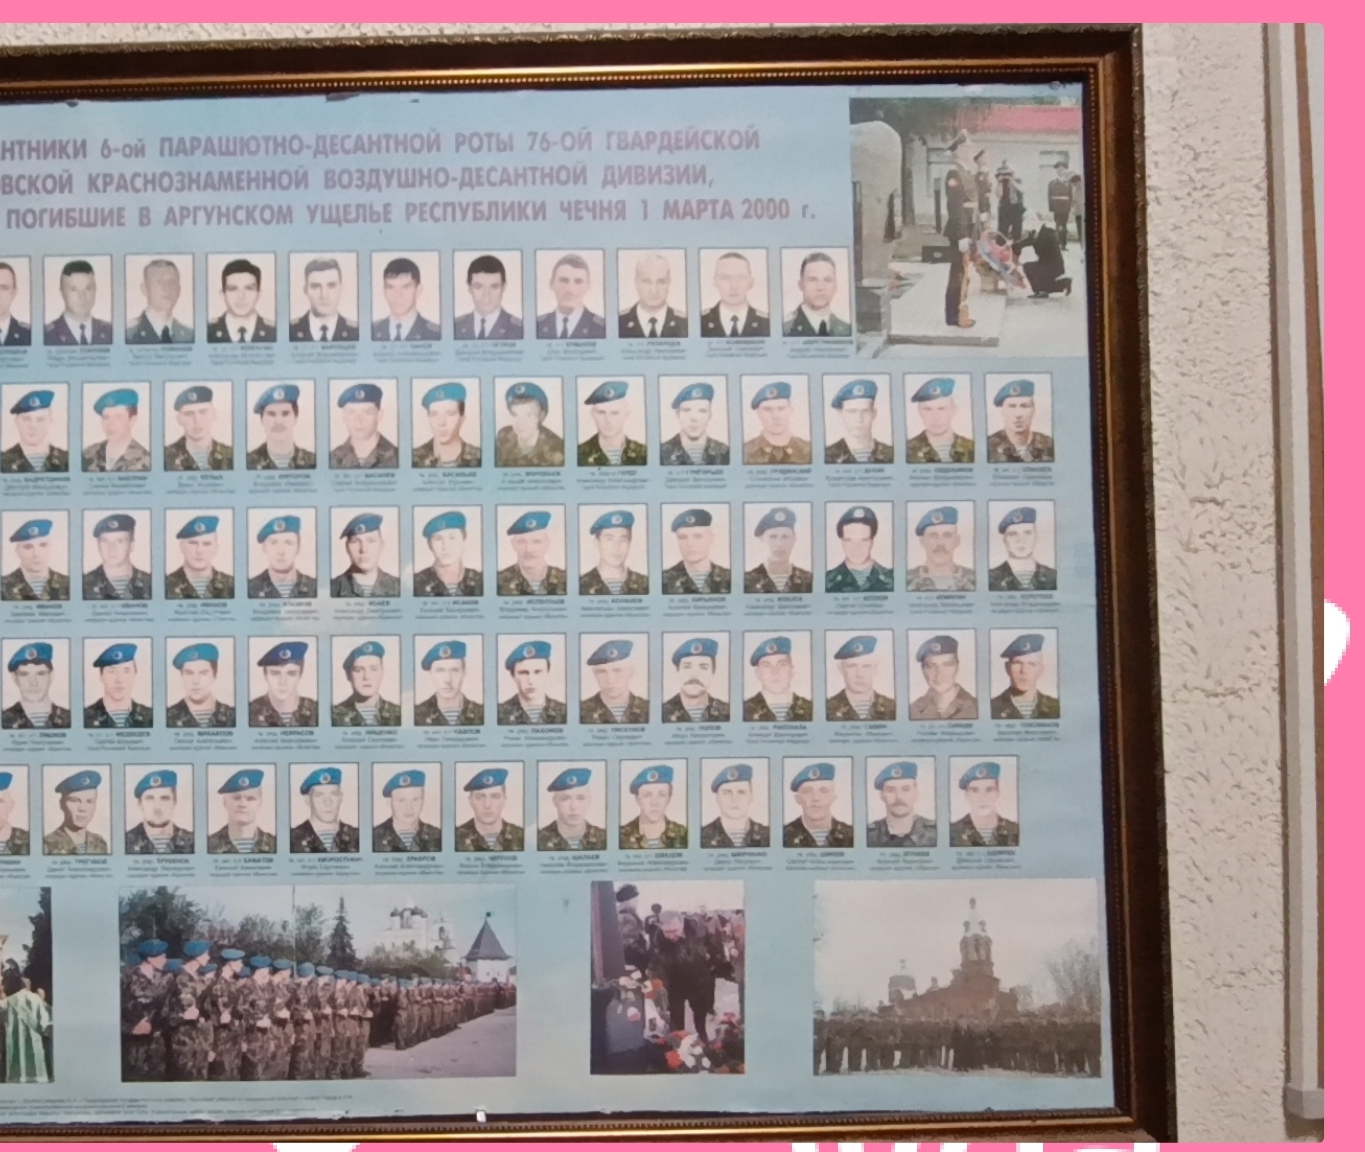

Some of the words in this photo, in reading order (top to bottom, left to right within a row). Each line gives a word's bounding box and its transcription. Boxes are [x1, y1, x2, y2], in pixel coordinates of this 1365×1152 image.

[100, 136, 146, 159] 6-ой
[158, 127, 441, 160] ПАРАШЮТНО-ДЕСАНТНОЙ
[454, 131, 515, 154] РОТЫ
[526, 127, 593, 153] 76-ОЙ
[605, 123, 760, 155] ГВАРДЕЙСКОЙ
[87, 163, 309, 195] КРАСНОЗНАМЕННОЙ
[323, 160, 588, 191] ВОЗДУШНО-ДЕСАНТНОЙ
[601, 164, 714, 190] ДИВИЗИИ,
[6, 206, 126, 230] ПОГИБШИЕ
[138, 206, 152, 227] В
[163, 204, 294, 228] АРГУНСКОМ
[306, 202, 392, 227] УЩЕЛЬЕ
[405, 200, 548, 223] РЕСПУБЛИКИ
[559, 199, 627, 222] ЧЕЧНЯ
[640, 199, 649, 221] 1
[662, 198, 735, 221] МАРТА
[741, 198, 790, 221] 2000
[800, 204, 816, 220] г.
